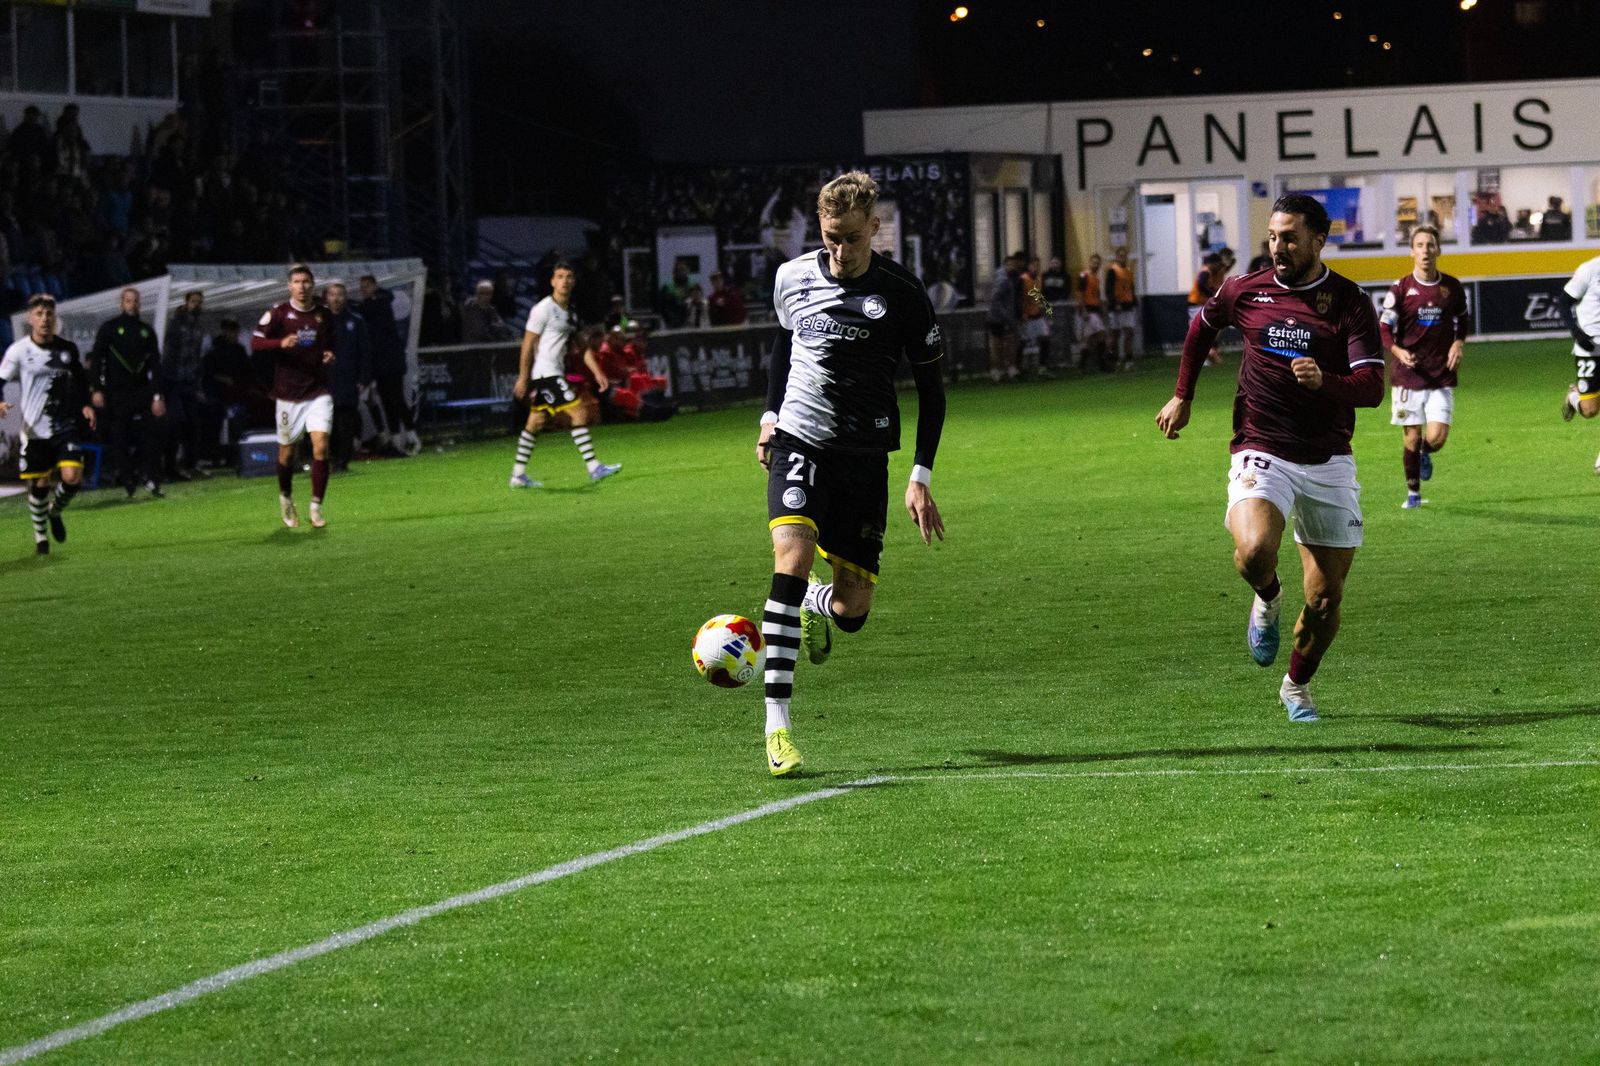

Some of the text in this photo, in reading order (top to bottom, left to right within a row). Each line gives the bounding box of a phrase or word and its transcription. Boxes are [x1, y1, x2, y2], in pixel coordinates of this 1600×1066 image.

[1076, 98, 1554, 191] PANELAIS
[1267, 326, 1311, 340] Estrella
[1268, 337, 1309, 350] Galicia
[1577, 360, 1596, 378] 22
[281, 410, 289, 426] 8
[786, 452, 817, 487] 21
[1243, 454, 1272, 471] 15
